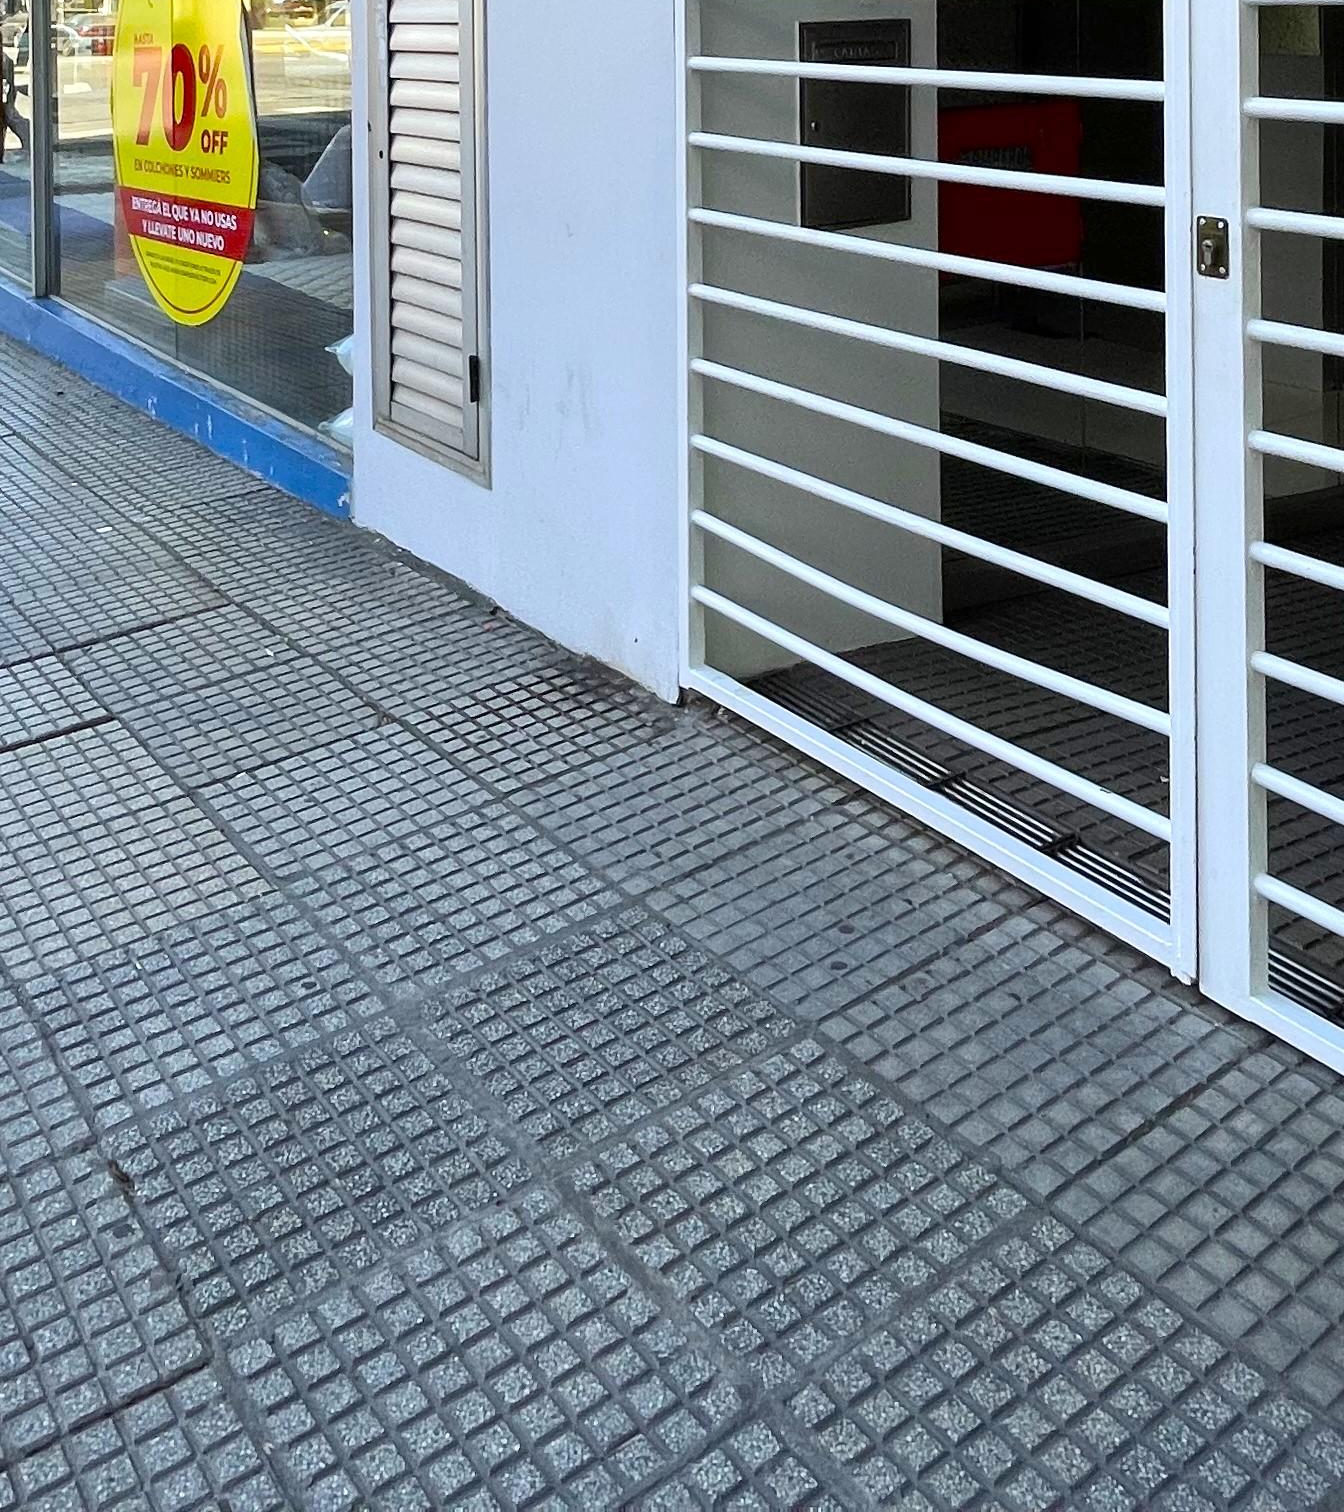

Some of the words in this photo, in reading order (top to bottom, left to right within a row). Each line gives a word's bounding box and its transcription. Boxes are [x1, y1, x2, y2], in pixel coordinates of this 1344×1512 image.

[132, 42, 228, 152] 70%
[201, 130, 229, 155] OFF
[134, 158, 143, 172] EN
[143, 160, 184, 178] COLCHONES
[190, 165, 231, 185] SOMMIERS
[162, 201, 172, 218] EL
[172, 204, 189, 222] QUE
[189, 207, 201, 224] YA
[201, 209, 214, 226] NO
[214, 211, 238, 231] USAS
[148, 221, 177, 240] LLEVATE
[177, 226, 196, 245] UNO
[196, 230, 225, 251] NUEVO
